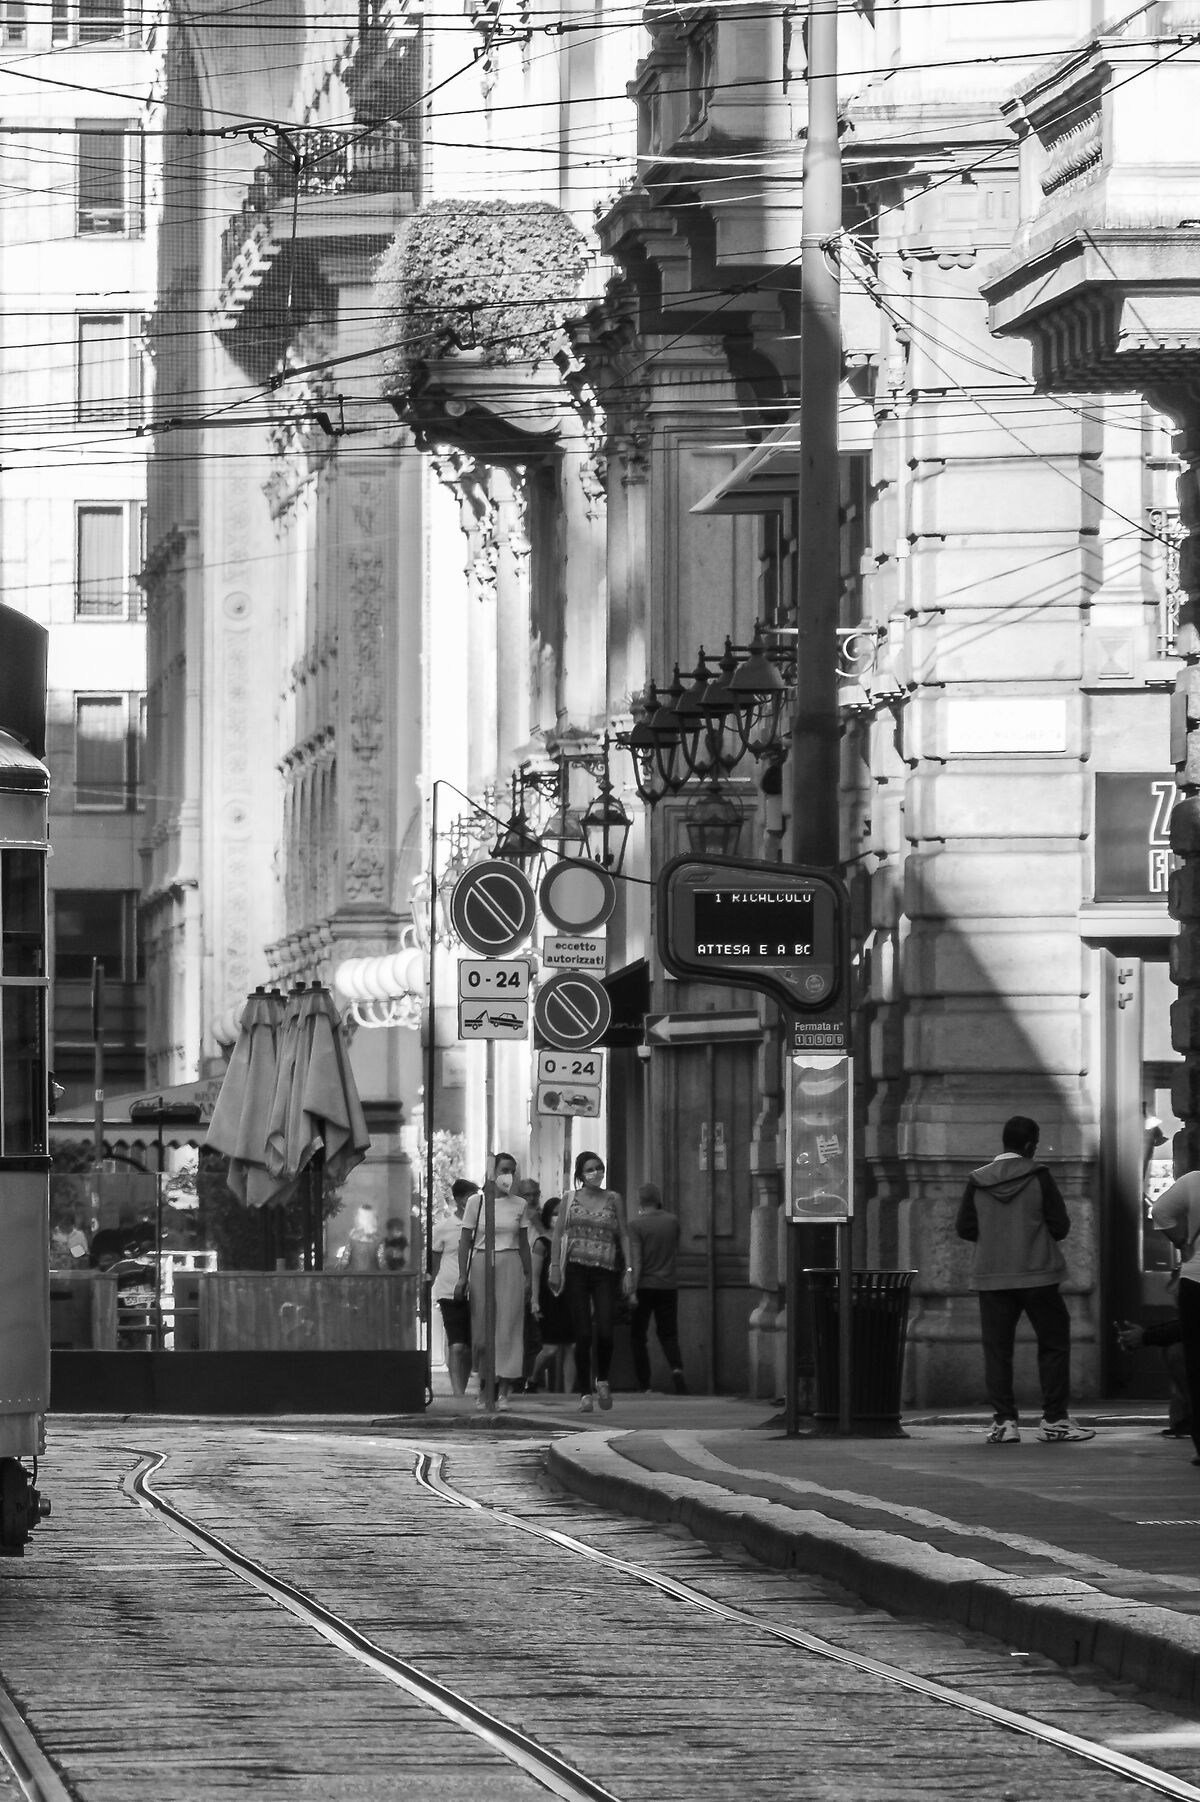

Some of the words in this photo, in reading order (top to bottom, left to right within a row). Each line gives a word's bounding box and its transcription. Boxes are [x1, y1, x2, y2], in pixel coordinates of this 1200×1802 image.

[555, 942, 597, 951] eccetto
[697, 944, 751, 955] ATTESA
[759, 944, 768, 955] E
[777, 944, 786, 955] A
[546, 955, 604, 965] autorizzati
[496, 971, 521, 988] 24
[794, 1022, 831, 1031] Fermata
[571, 1061, 595, 1075] 24
